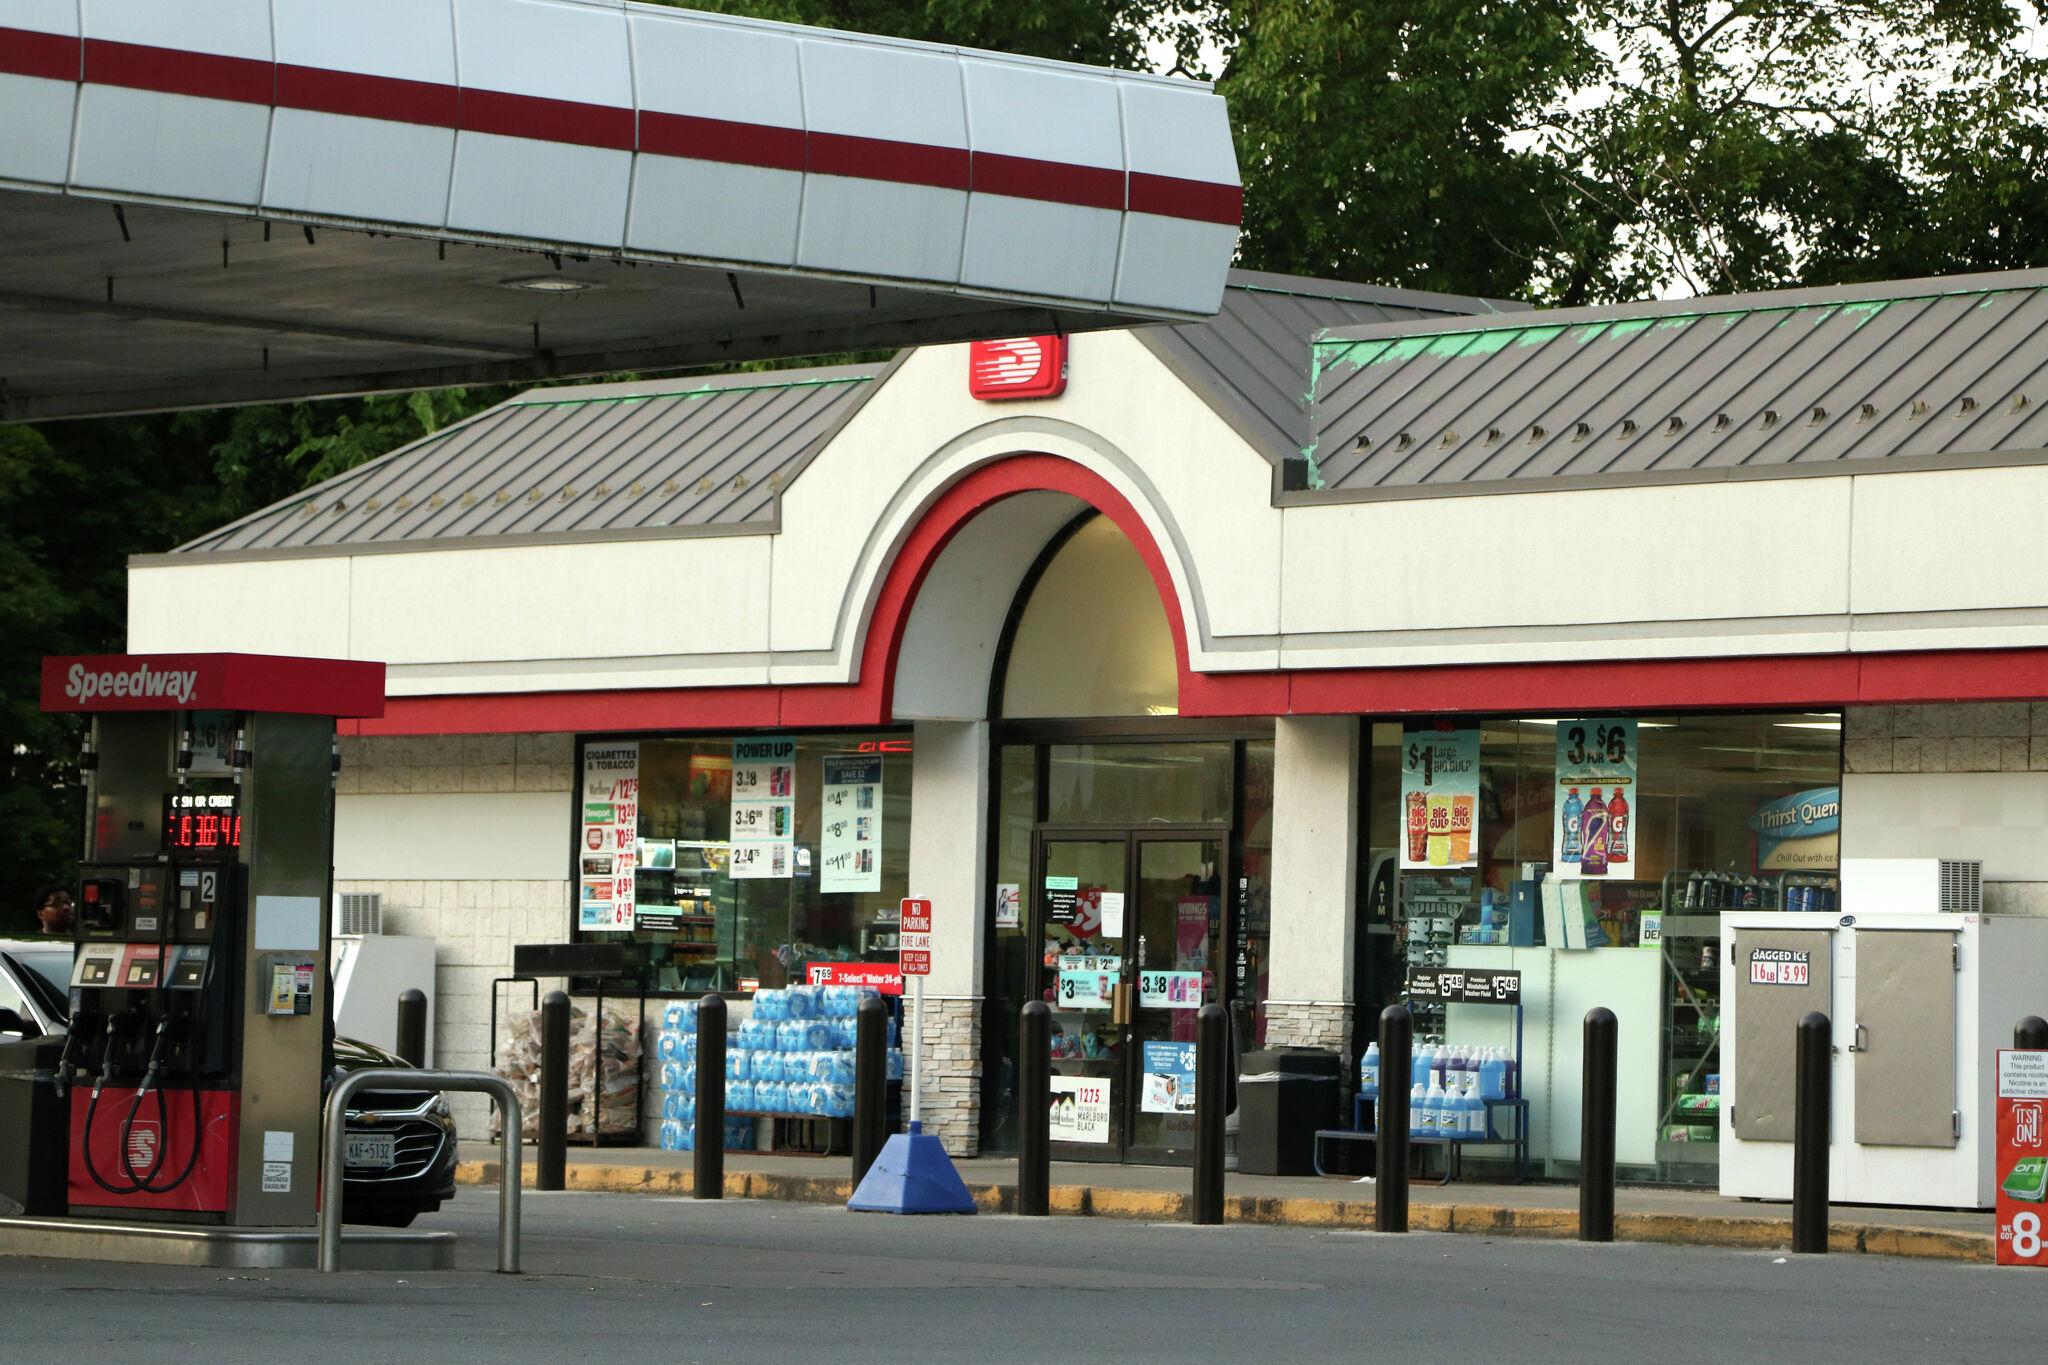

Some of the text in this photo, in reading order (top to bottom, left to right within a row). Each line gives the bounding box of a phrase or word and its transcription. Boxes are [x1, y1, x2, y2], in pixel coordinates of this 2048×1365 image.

[66, 664, 197, 704] Speedway
[736, 742, 793, 759] POWER UP
[1567, 724, 1626, 764] 3 FOR $6
[586, 750, 637, 760] CIGARETTES
[596, 761, 635, 770] TOBACCO
[1409, 743, 1457, 786] $1 Large
[1449, 760, 1472, 773] GULP
[736, 770, 743, 787] 3
[172, 795, 193, 808] CSH
[735, 810, 742, 825] 3
[1429, 817, 1449, 829] GULP
[1451, 814, 1470, 827] GULP
[1760, 806, 1797, 829] Thirst
[734, 849, 740, 864] 2
[1776, 852, 1834, 863] Chill Out with Ice
[203, 875, 214, 900] 2
[1378, 880, 1387, 917] ATM
[911, 902, 921, 915] NO
[903, 917, 929, 930] PARKING
[1644, 919, 1662, 930] Blu
[902, 935, 930, 948] FIRE LANE
[904, 953, 927, 962] KEEP CLEAR
[1752, 949, 1808, 962] BAGGED ICE
[903, 963, 908, 971] AT
[1779, 964, 1807, 982] $5.99
[866, 973, 885, 984] Water
[1142, 975, 1150, 993] 3
[1154, 975, 1167, 994] $8
[1060, 978, 1075, 1000] $3
[2023, 1063, 2045, 1072] product
[2001, 1088, 2027, 1096] addictive
[1077, 1112, 1108, 1122] MARLBORO
[1077, 1121, 1095, 1131] BLACK
[2000, 1232, 2013, 1240] GOT
[2012, 1212, 2041, 1257] 8
